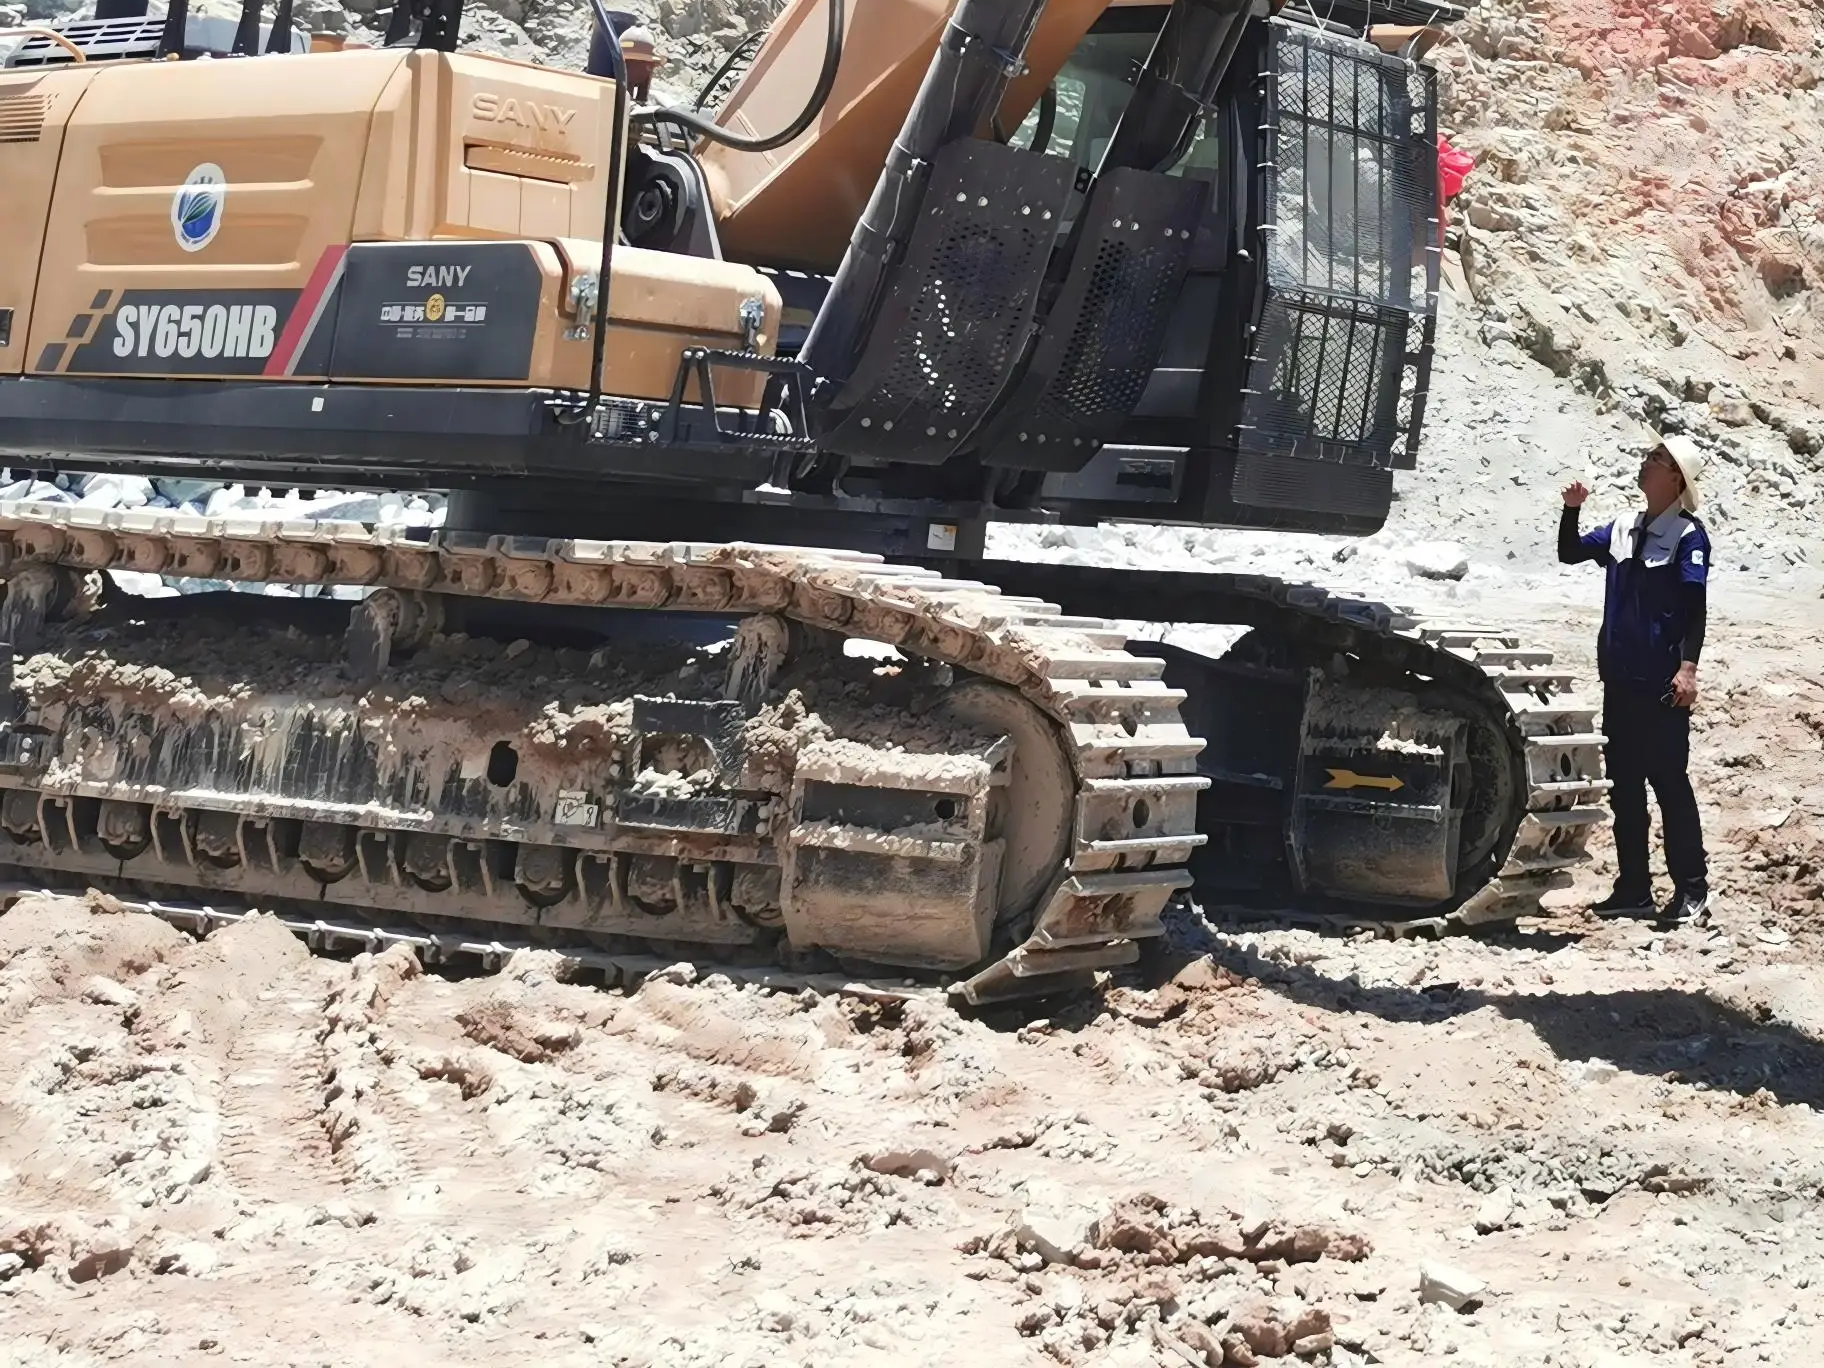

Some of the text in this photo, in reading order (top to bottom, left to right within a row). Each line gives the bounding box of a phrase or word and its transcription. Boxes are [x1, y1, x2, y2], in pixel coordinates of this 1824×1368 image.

[473, 92, 577, 134] SANY
[406, 265, 472, 287] SANY
[113, 304, 277, 358] SY650HB
